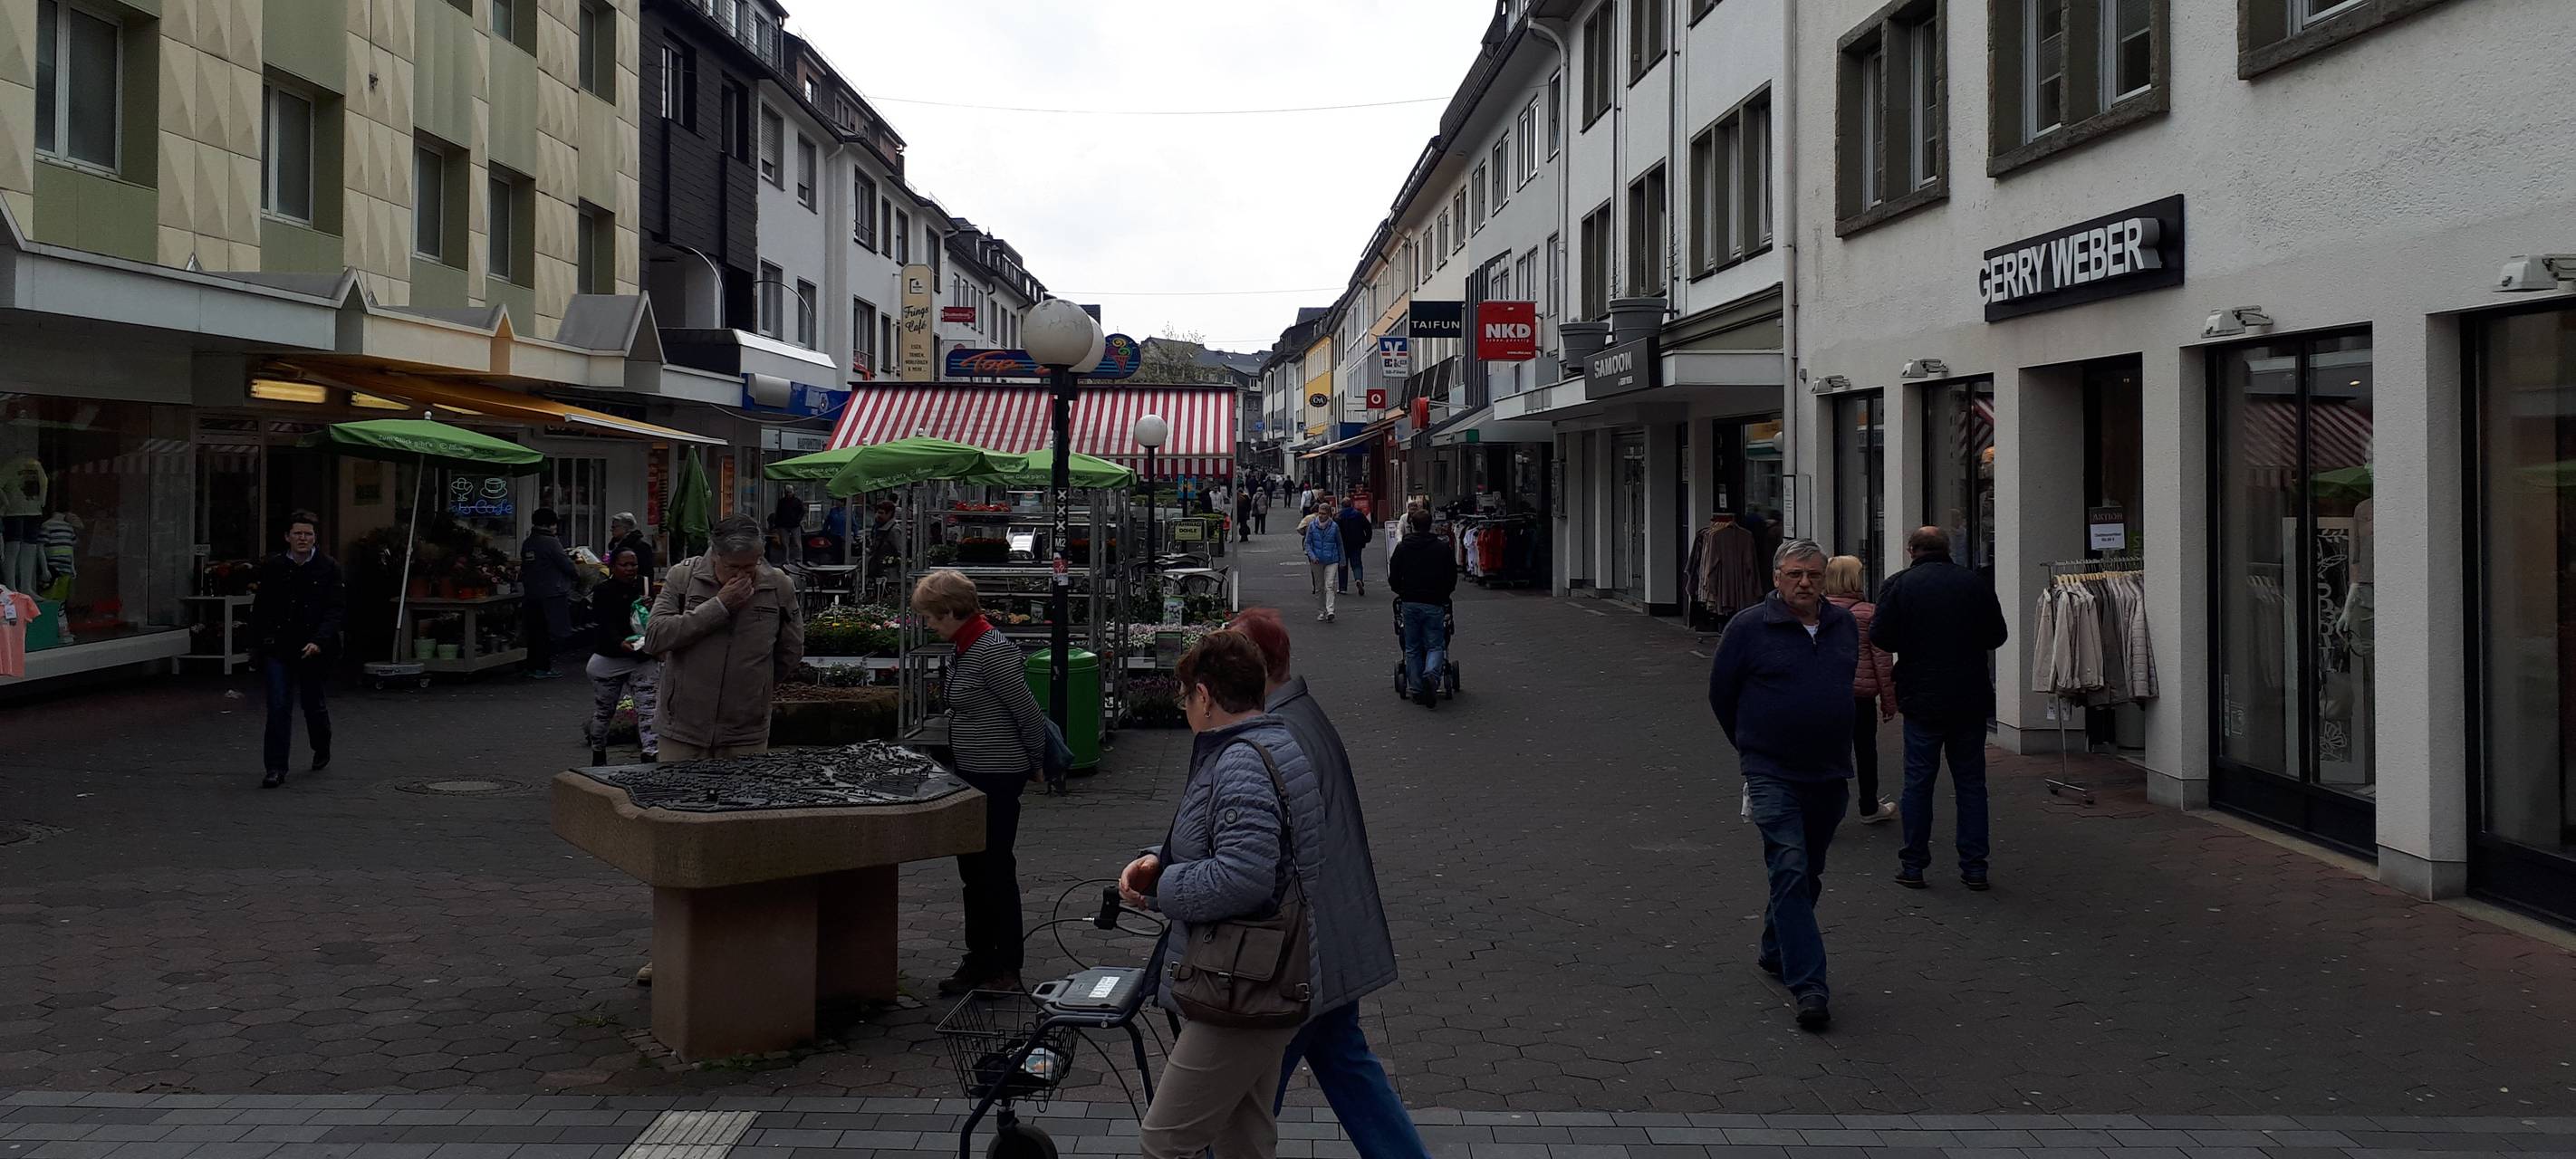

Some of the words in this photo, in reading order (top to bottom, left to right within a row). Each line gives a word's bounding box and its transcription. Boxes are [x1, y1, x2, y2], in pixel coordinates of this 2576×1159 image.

[1978, 243, 2047, 305] GERRY
[2050, 217, 2152, 289] WEBER
[904, 305, 929, 319] Frings
[1411, 320, 1461, 330] TAIFUN
[1485, 322, 1532, 339] NKD
[959, 350, 1025, 372] Top
[1594, 351, 1632, 378] SAMOON
[2093, 512, 2123, 522] AKTION
[1055, 538, 1066, 548] M2
